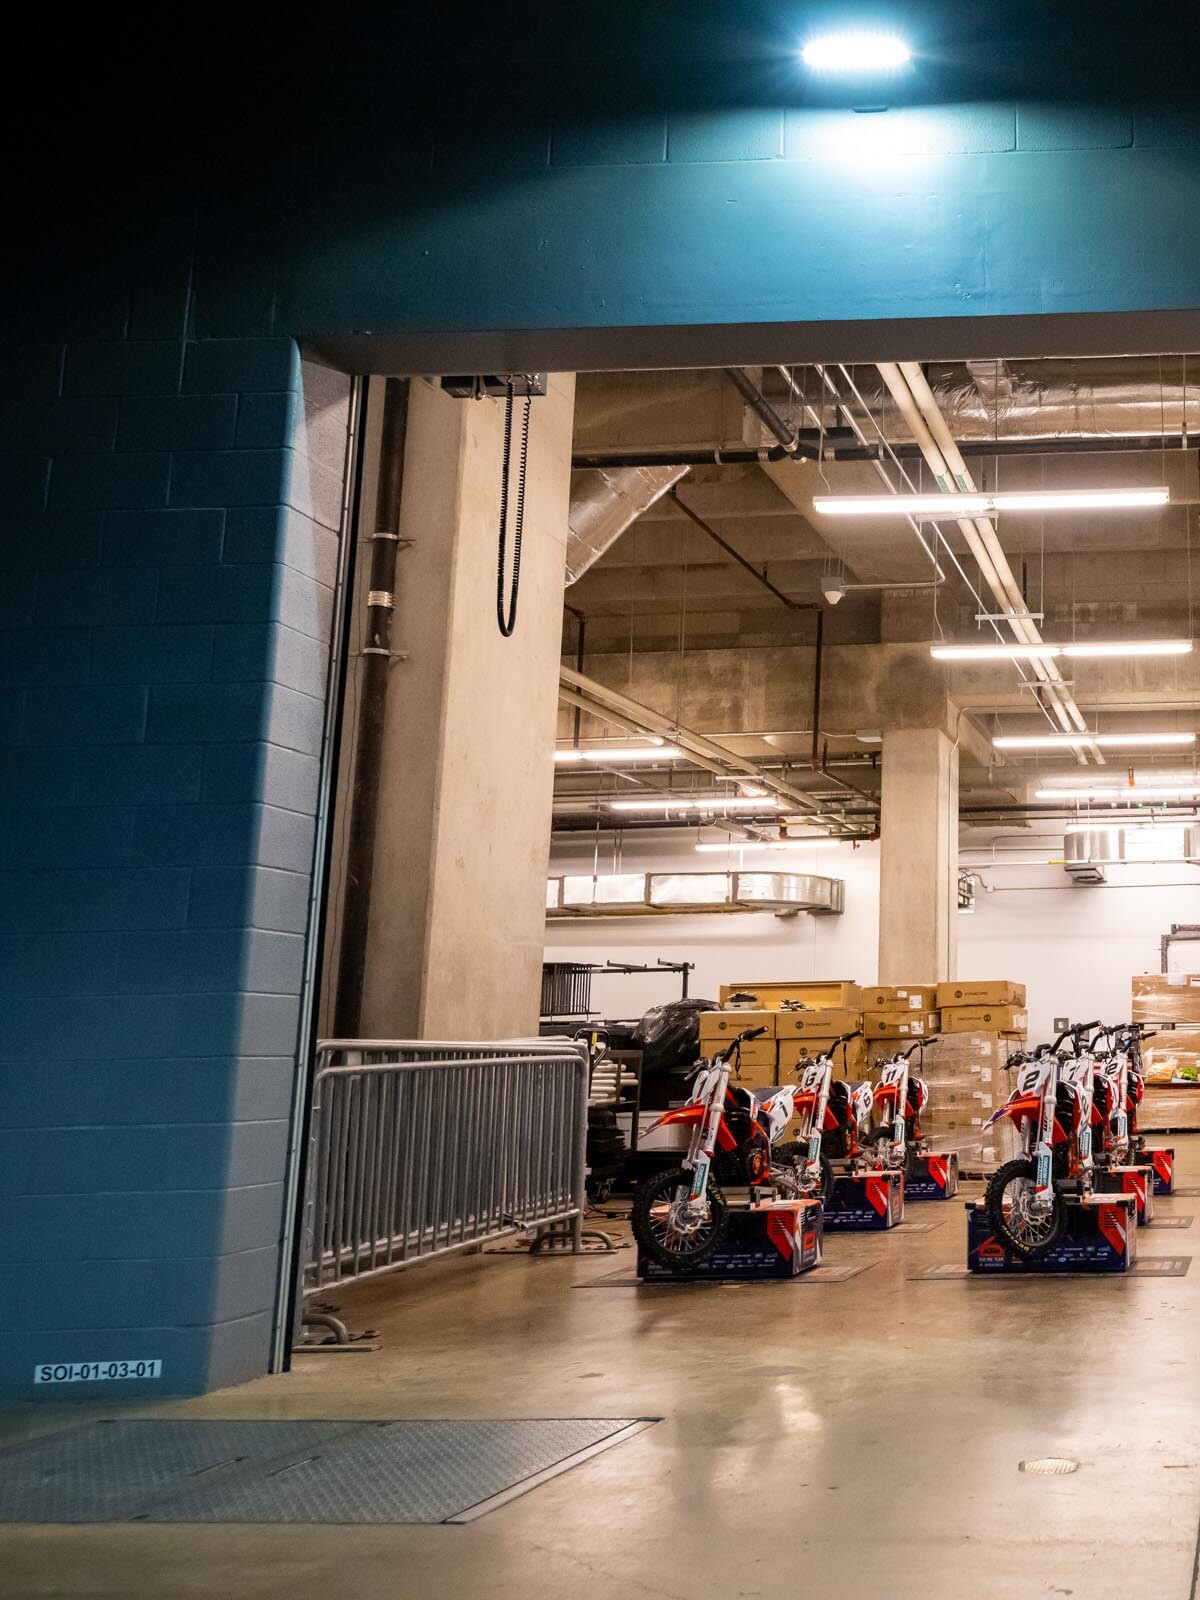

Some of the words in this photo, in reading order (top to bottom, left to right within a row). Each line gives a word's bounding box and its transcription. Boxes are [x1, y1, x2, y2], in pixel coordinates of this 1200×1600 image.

[885, 1069, 897, 1082] 11
[1104, 1062, 1118, 1075] 12
[1022, 1070, 1040, 1091] 2
[40, 1361, 156, 1382] SOI-01-03-01
